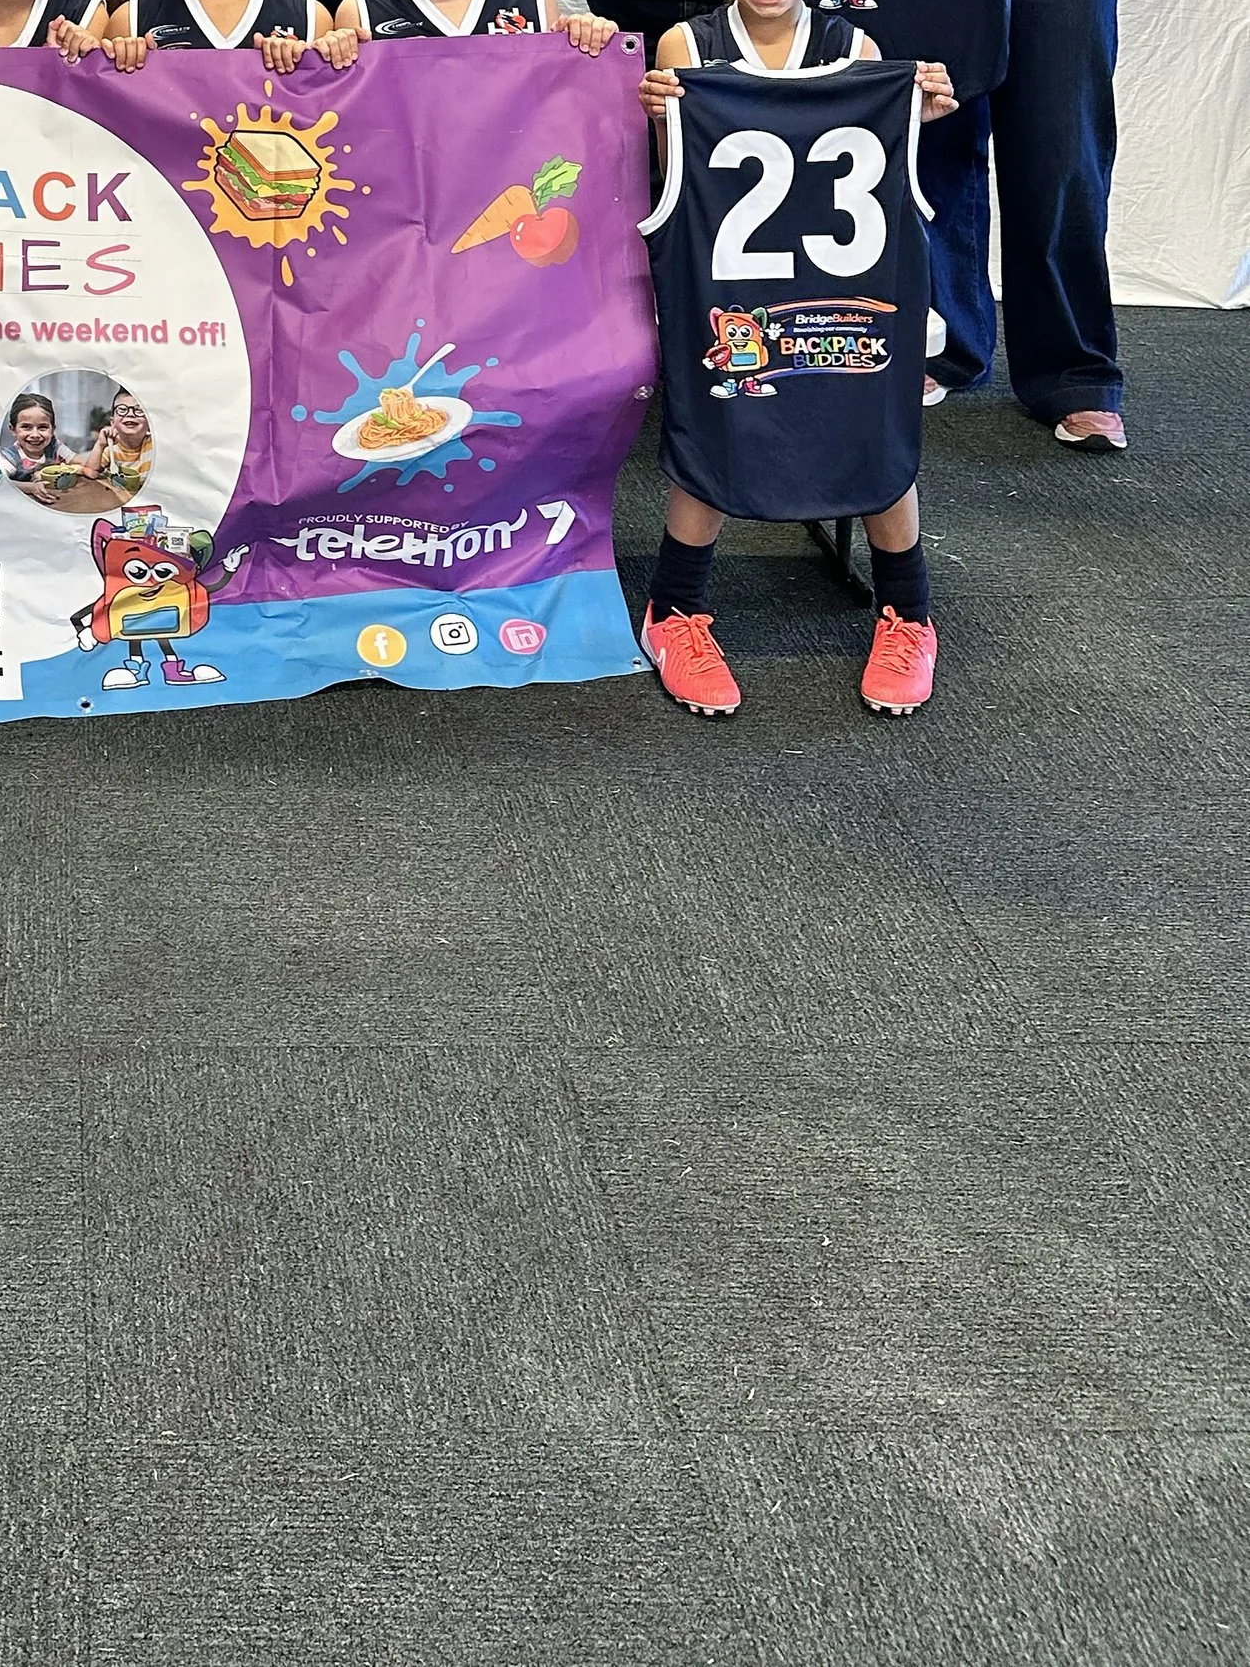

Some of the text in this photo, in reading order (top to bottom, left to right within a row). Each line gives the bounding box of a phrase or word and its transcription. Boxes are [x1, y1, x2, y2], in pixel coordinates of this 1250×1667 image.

[708, 127, 886, 280] 23
[795, 313, 873, 325] BridgeBuilders
[31, 317, 170, 345] weekend
[178, 320, 227, 348] off!
[780, 336, 888, 356] BACKPACK
[793, 354, 876, 368] BUDDIES
[298, 514, 470, 534] PROUDLY SUPPORTED BY
[268, 508, 529, 568] telethon
